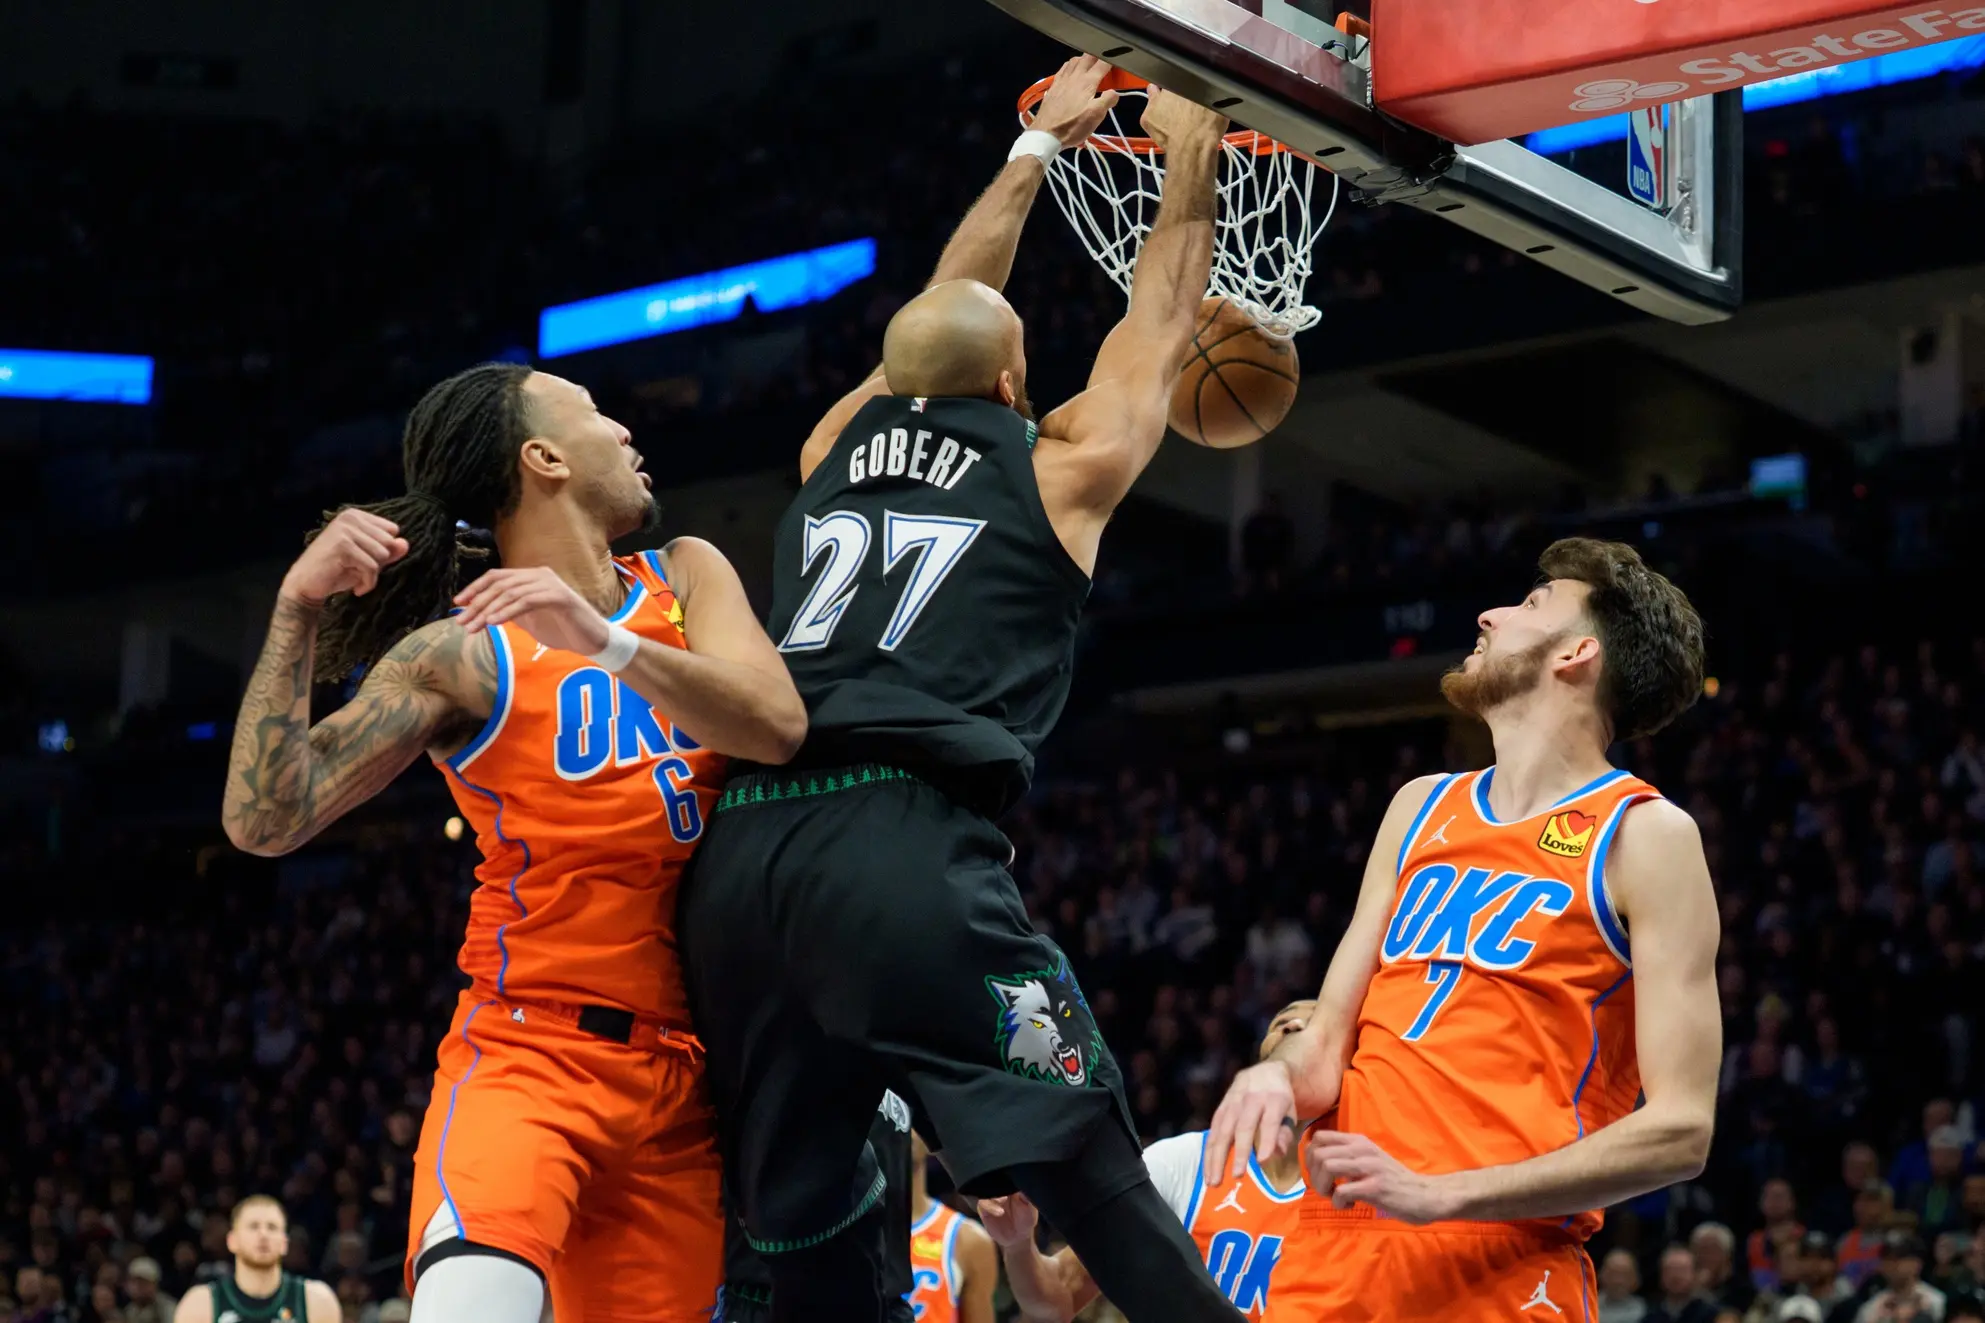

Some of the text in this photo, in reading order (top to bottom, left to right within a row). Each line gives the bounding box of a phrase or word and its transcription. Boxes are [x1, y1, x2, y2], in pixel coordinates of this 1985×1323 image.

[1632, 164, 1652, 195] NBA
[849, 427, 982, 490] GOBERT
[777, 508, 988, 653] 27
[652, 756, 704, 843] 6
[1380, 863, 1574, 970] OKC
[1400, 960, 1464, 1041] 7
[1205, 1227, 1284, 1316] OK
